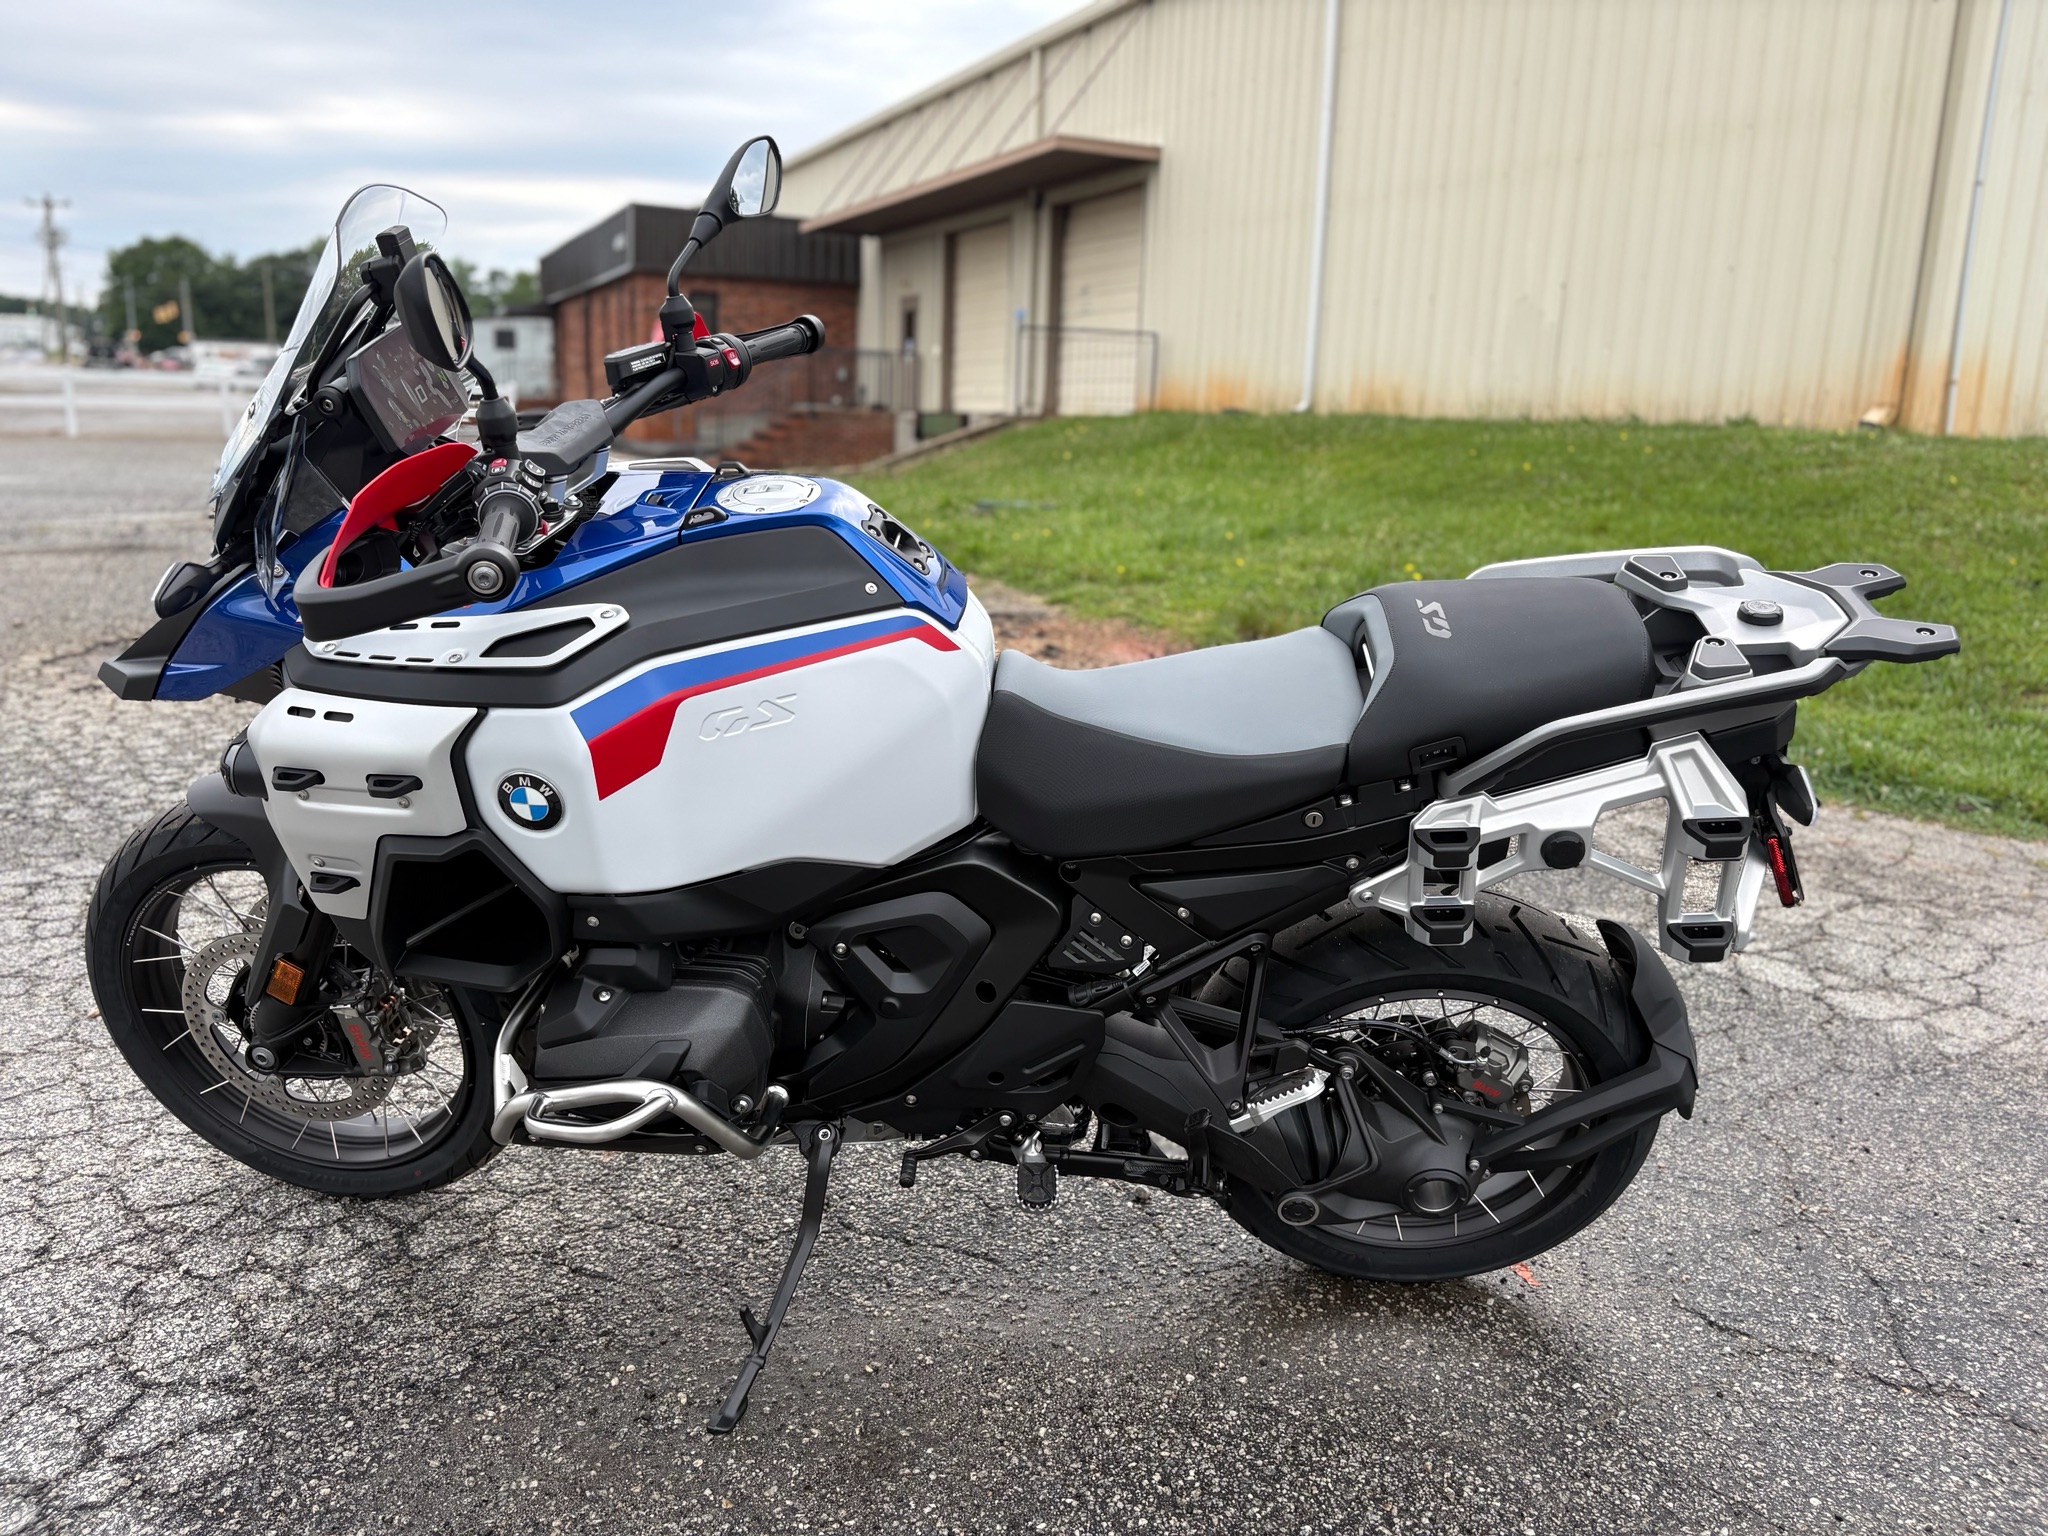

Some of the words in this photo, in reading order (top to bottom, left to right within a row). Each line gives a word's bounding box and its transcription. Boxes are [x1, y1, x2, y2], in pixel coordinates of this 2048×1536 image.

[1415, 598, 1452, 639] GS
[698, 693, 798, 741] GS
[501, 776, 554, 797] BMW
[348, 1023, 376, 1061] BMW
[1472, 1079, 1503, 1098] BMW
